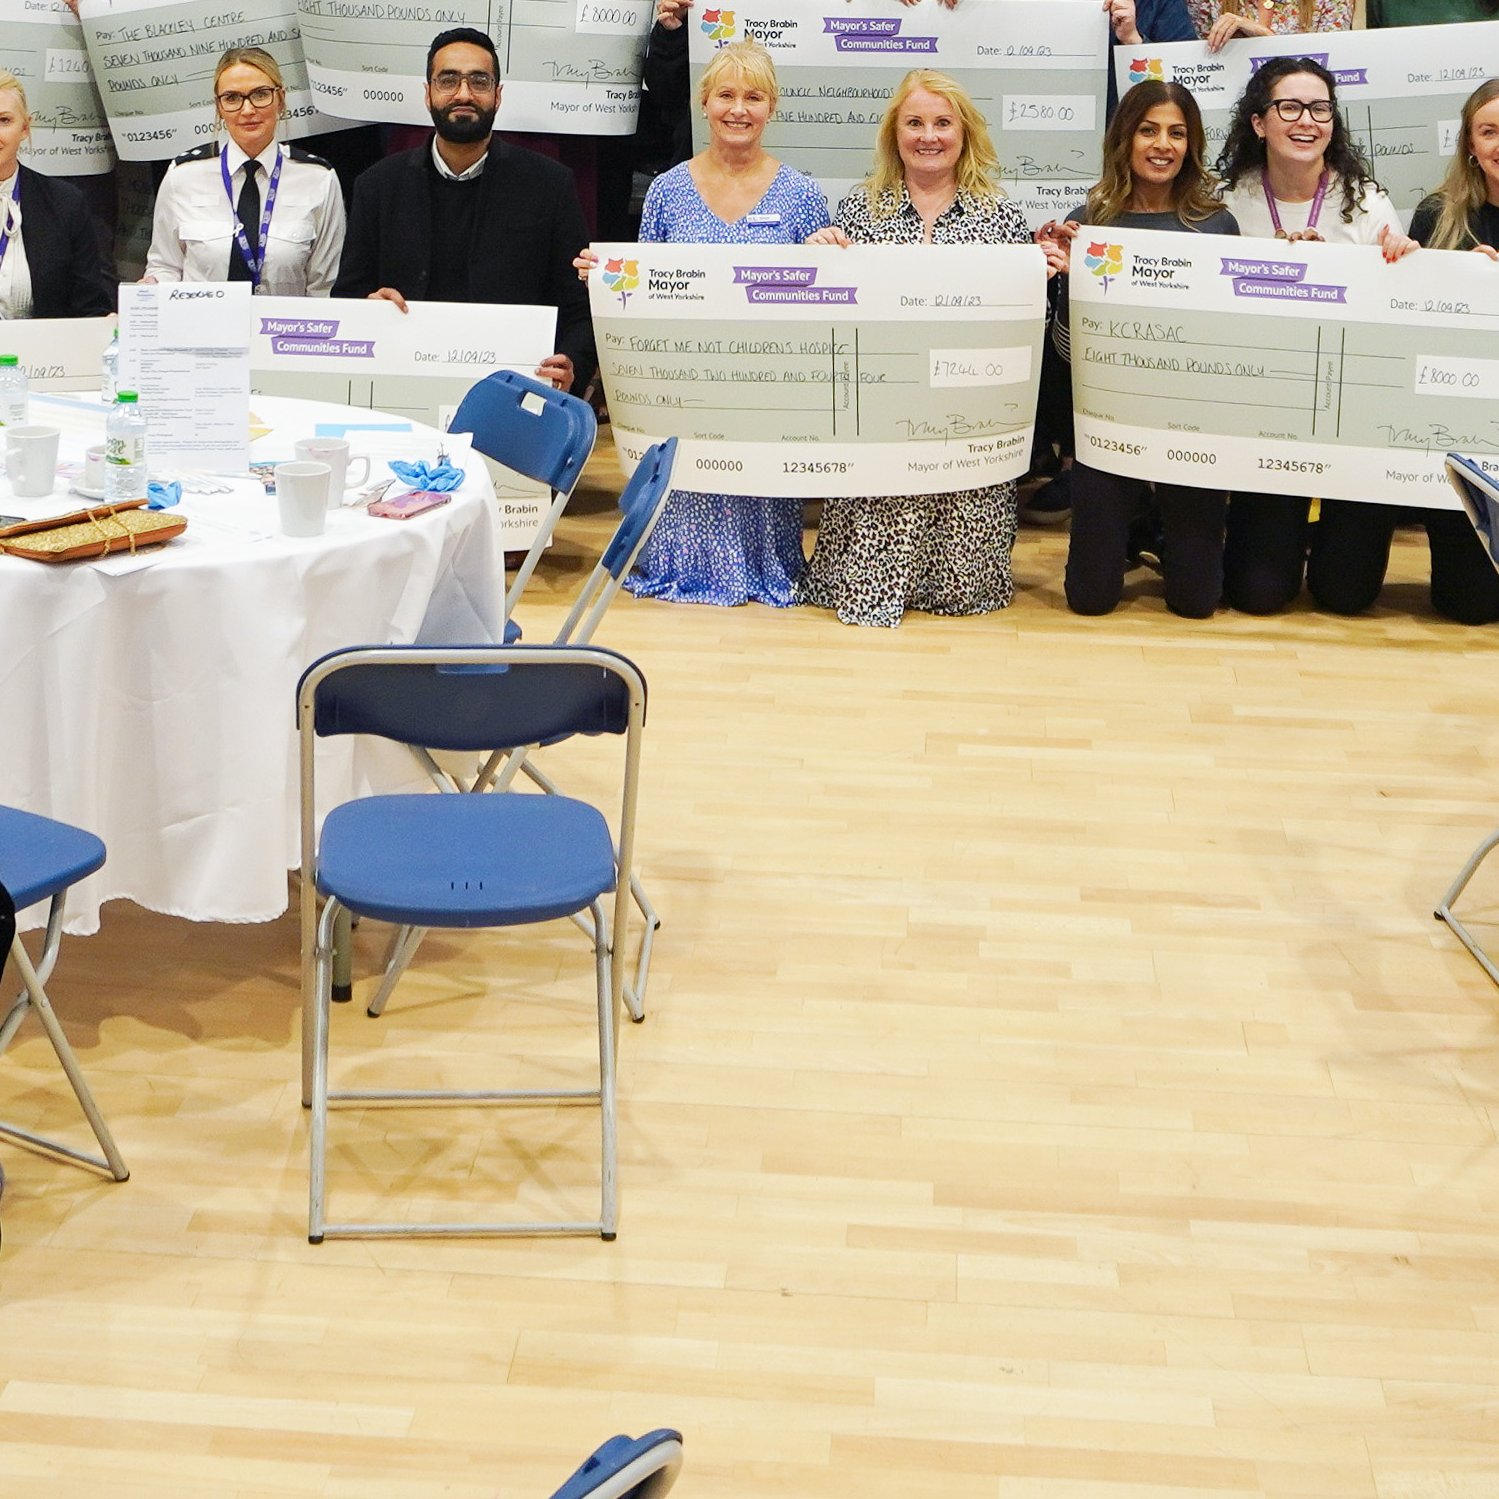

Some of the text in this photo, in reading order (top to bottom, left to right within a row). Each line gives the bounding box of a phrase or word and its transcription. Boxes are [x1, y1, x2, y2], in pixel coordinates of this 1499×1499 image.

[326, 1, 385, 19] THOUSAND
[744, 19, 798, 30] Tracy Brabin
[830, 20, 895, 34] Mayor's Safer
[744, 28, 783, 42] Mayor
[840, 38, 930, 52] Communities Fund
[977, 45, 1002, 56] Date:
[363, 89, 404, 103] 000000
[1133, 254, 1192, 269] Tracy Brabin
[649, 269, 706, 281] Tracy Brabin
[740, 269, 810, 283] Mayor's Safer
[1132, 265, 1175, 282] Mayor
[1228, 261, 1300, 277] Mayor's Safer
[648, 278, 690, 292] Mayor
[1239, 282, 1338, 300] Communities Fund
[752, 288, 849, 303] Communities Fund
[900, 295, 928, 307] Date:
[1389, 298, 1418, 312] Date:
[266, 320, 333, 336] Mayor's Safer
[1082, 316, 1103, 330] Pay:
[276, 340, 367, 355] Communities Fund
[605, 332, 724, 354] Pay: FORGET ME NOT
[414, 350, 439, 363] Date:
[967, 434, 1025, 456] Tracy Brabin
[1167, 449, 1218, 466] 000000
[695, 458, 743, 472] 000000
